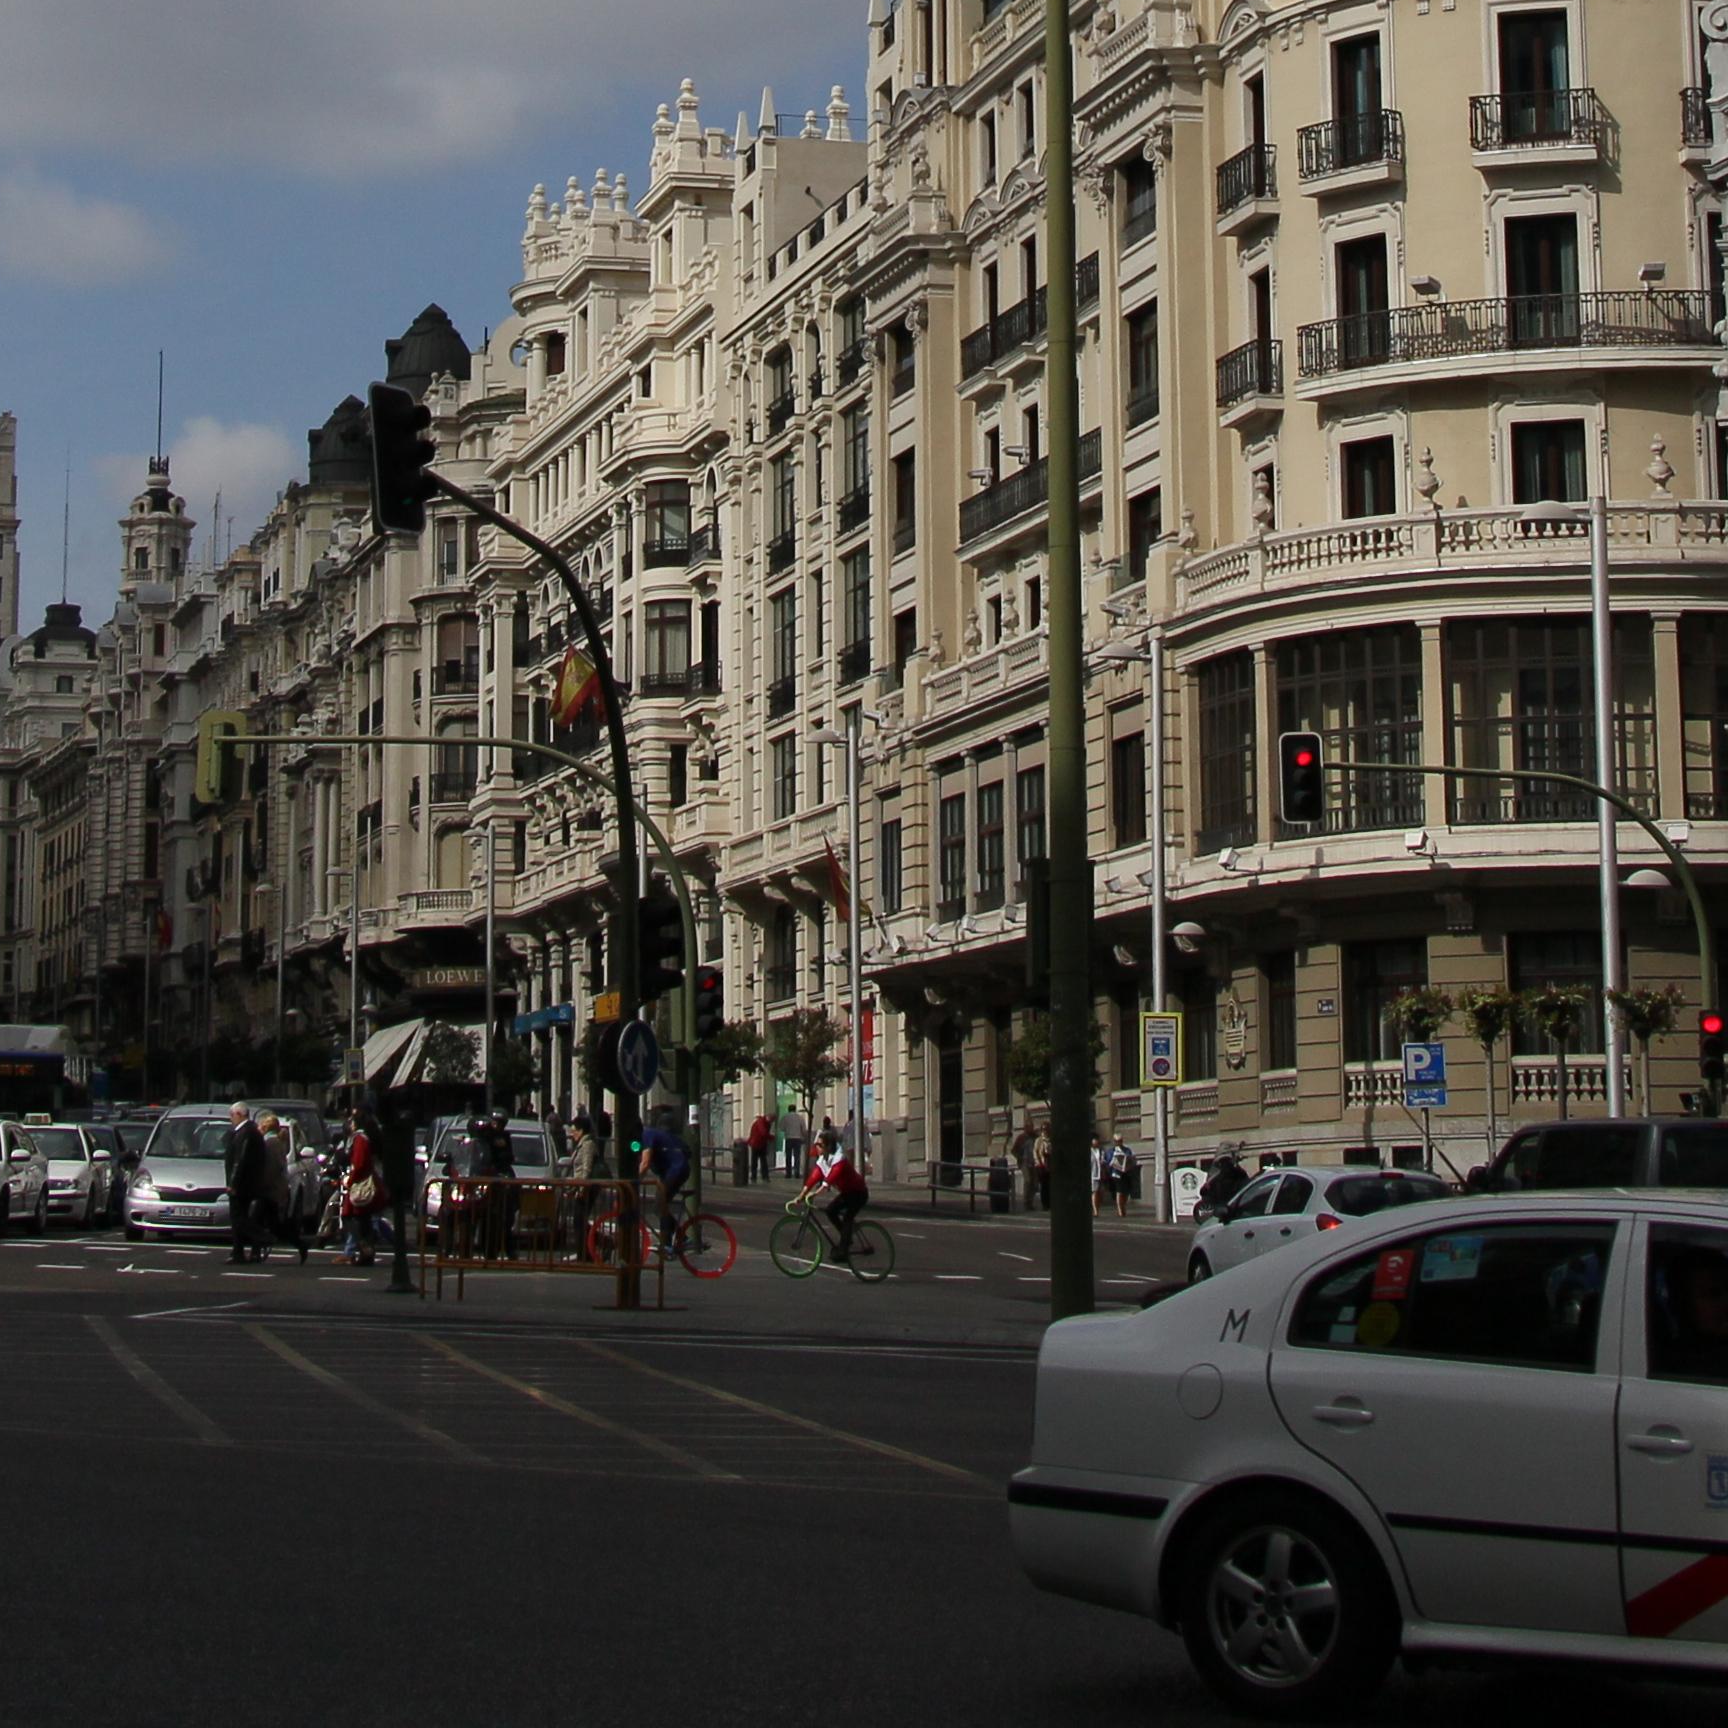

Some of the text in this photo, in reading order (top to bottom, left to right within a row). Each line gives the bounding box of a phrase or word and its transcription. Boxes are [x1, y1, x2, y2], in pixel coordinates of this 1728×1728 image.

[426, 969, 485, 984] LOEWE
[1406, 1047, 1431, 1080] P
[1219, 1308, 1252, 1343] M
